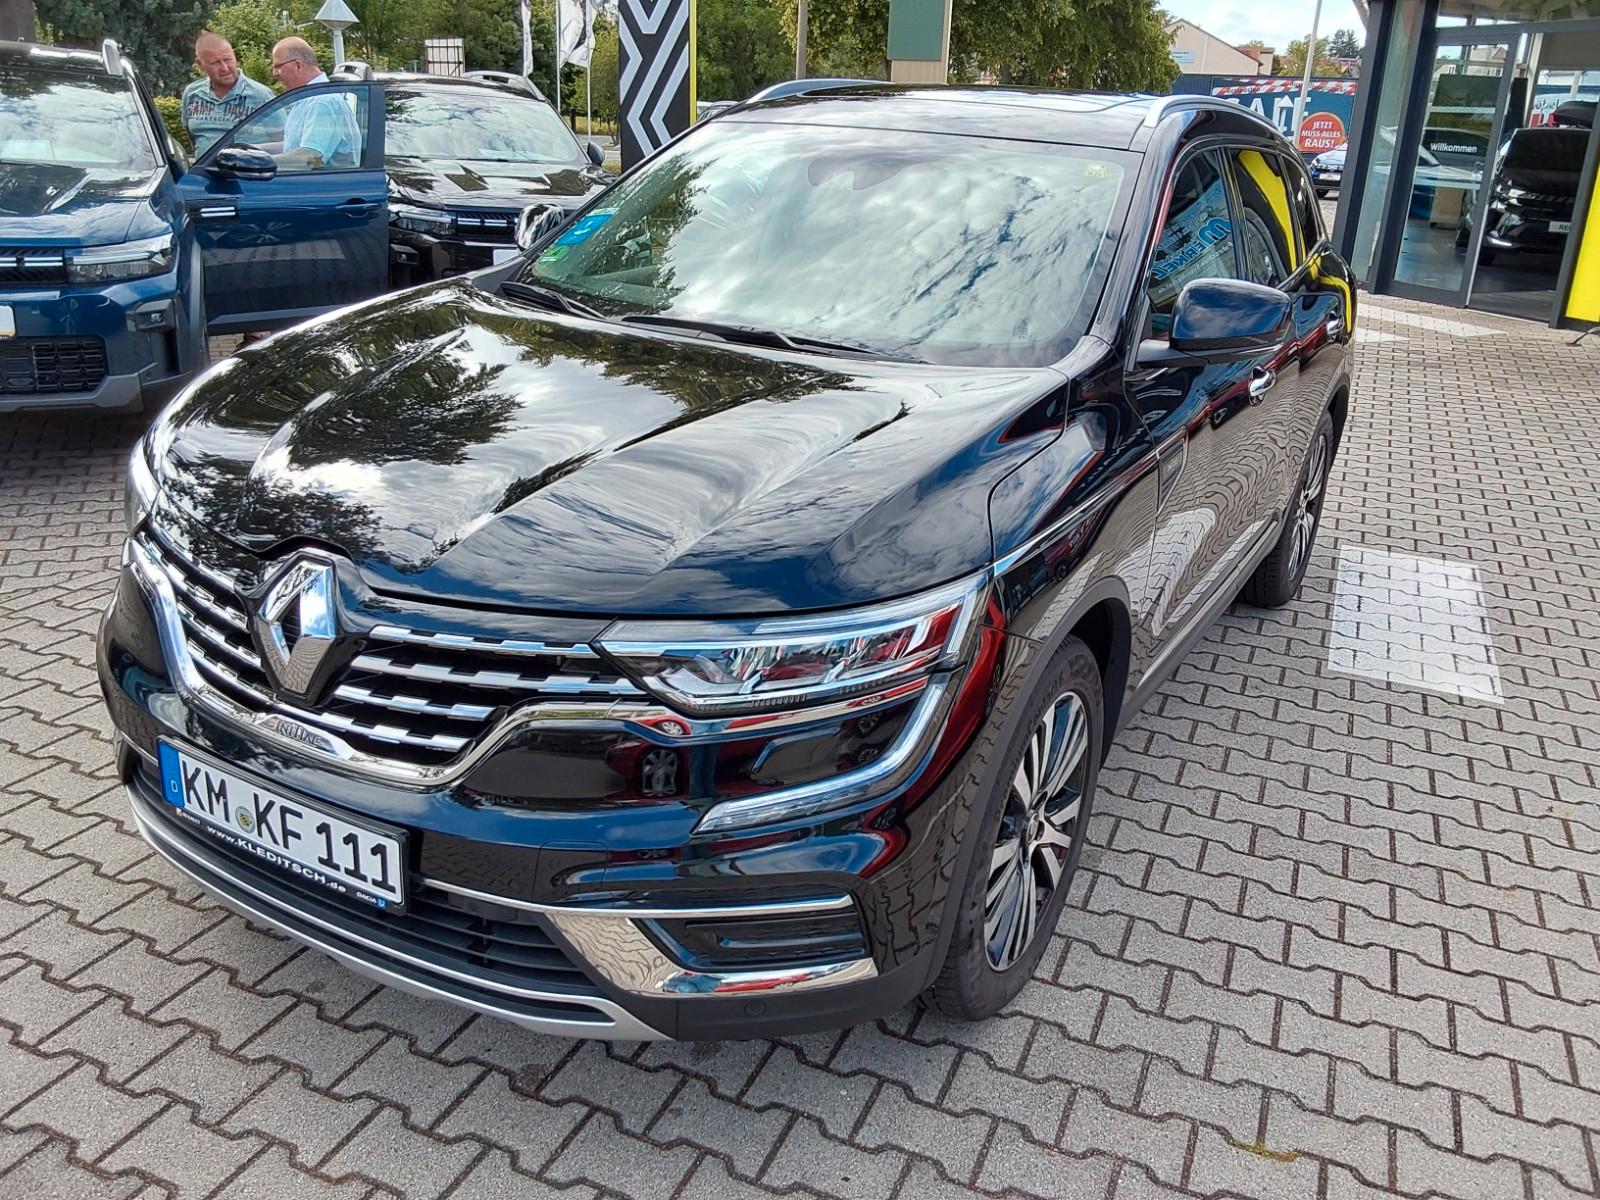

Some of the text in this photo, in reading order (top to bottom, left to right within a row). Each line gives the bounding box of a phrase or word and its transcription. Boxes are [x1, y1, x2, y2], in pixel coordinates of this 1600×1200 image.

[1312, 121, 1334, 130] JETZT
[1301, 130, 1342, 139] MUSS ALLES
[1304, 139, 1335, 149] RAUS!
[1430, 142, 1478, 153] Willkommen
[171, 760, 397, 894] D KM KF 111
[206, 825, 347, 893] www.KLEDITSCH.de
